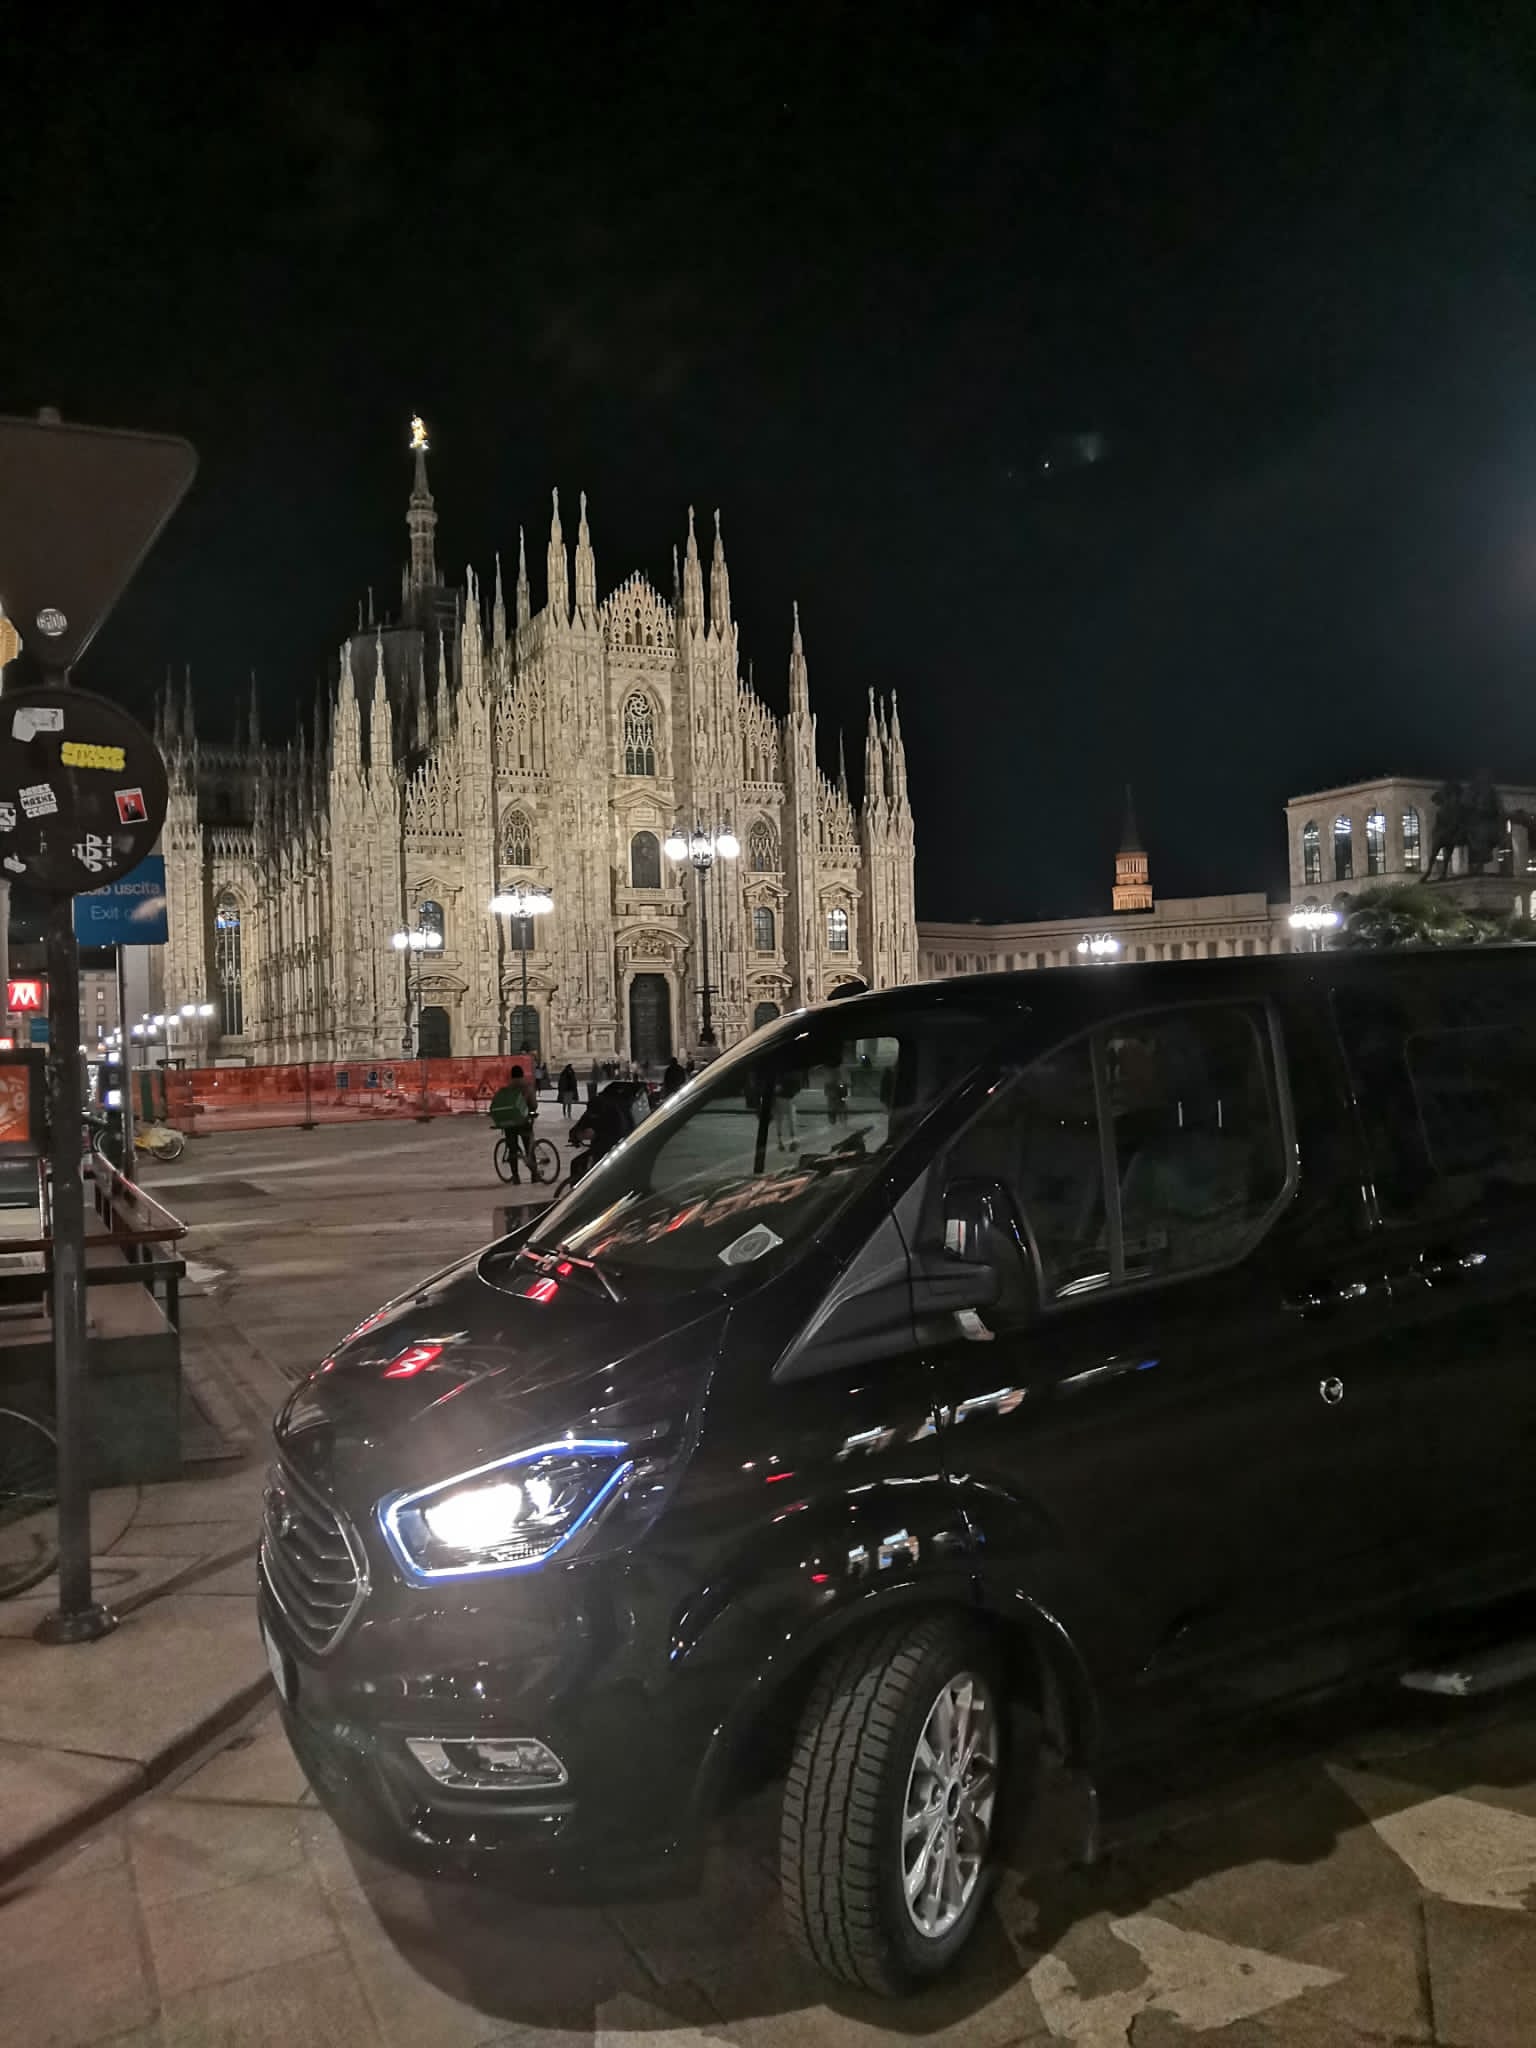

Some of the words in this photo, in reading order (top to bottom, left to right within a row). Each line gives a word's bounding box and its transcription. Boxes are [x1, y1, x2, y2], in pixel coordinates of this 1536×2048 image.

[114, 882, 160, 895] uscita
[90, 905, 119, 920] Exit
[11, 982, 39, 1006] M
